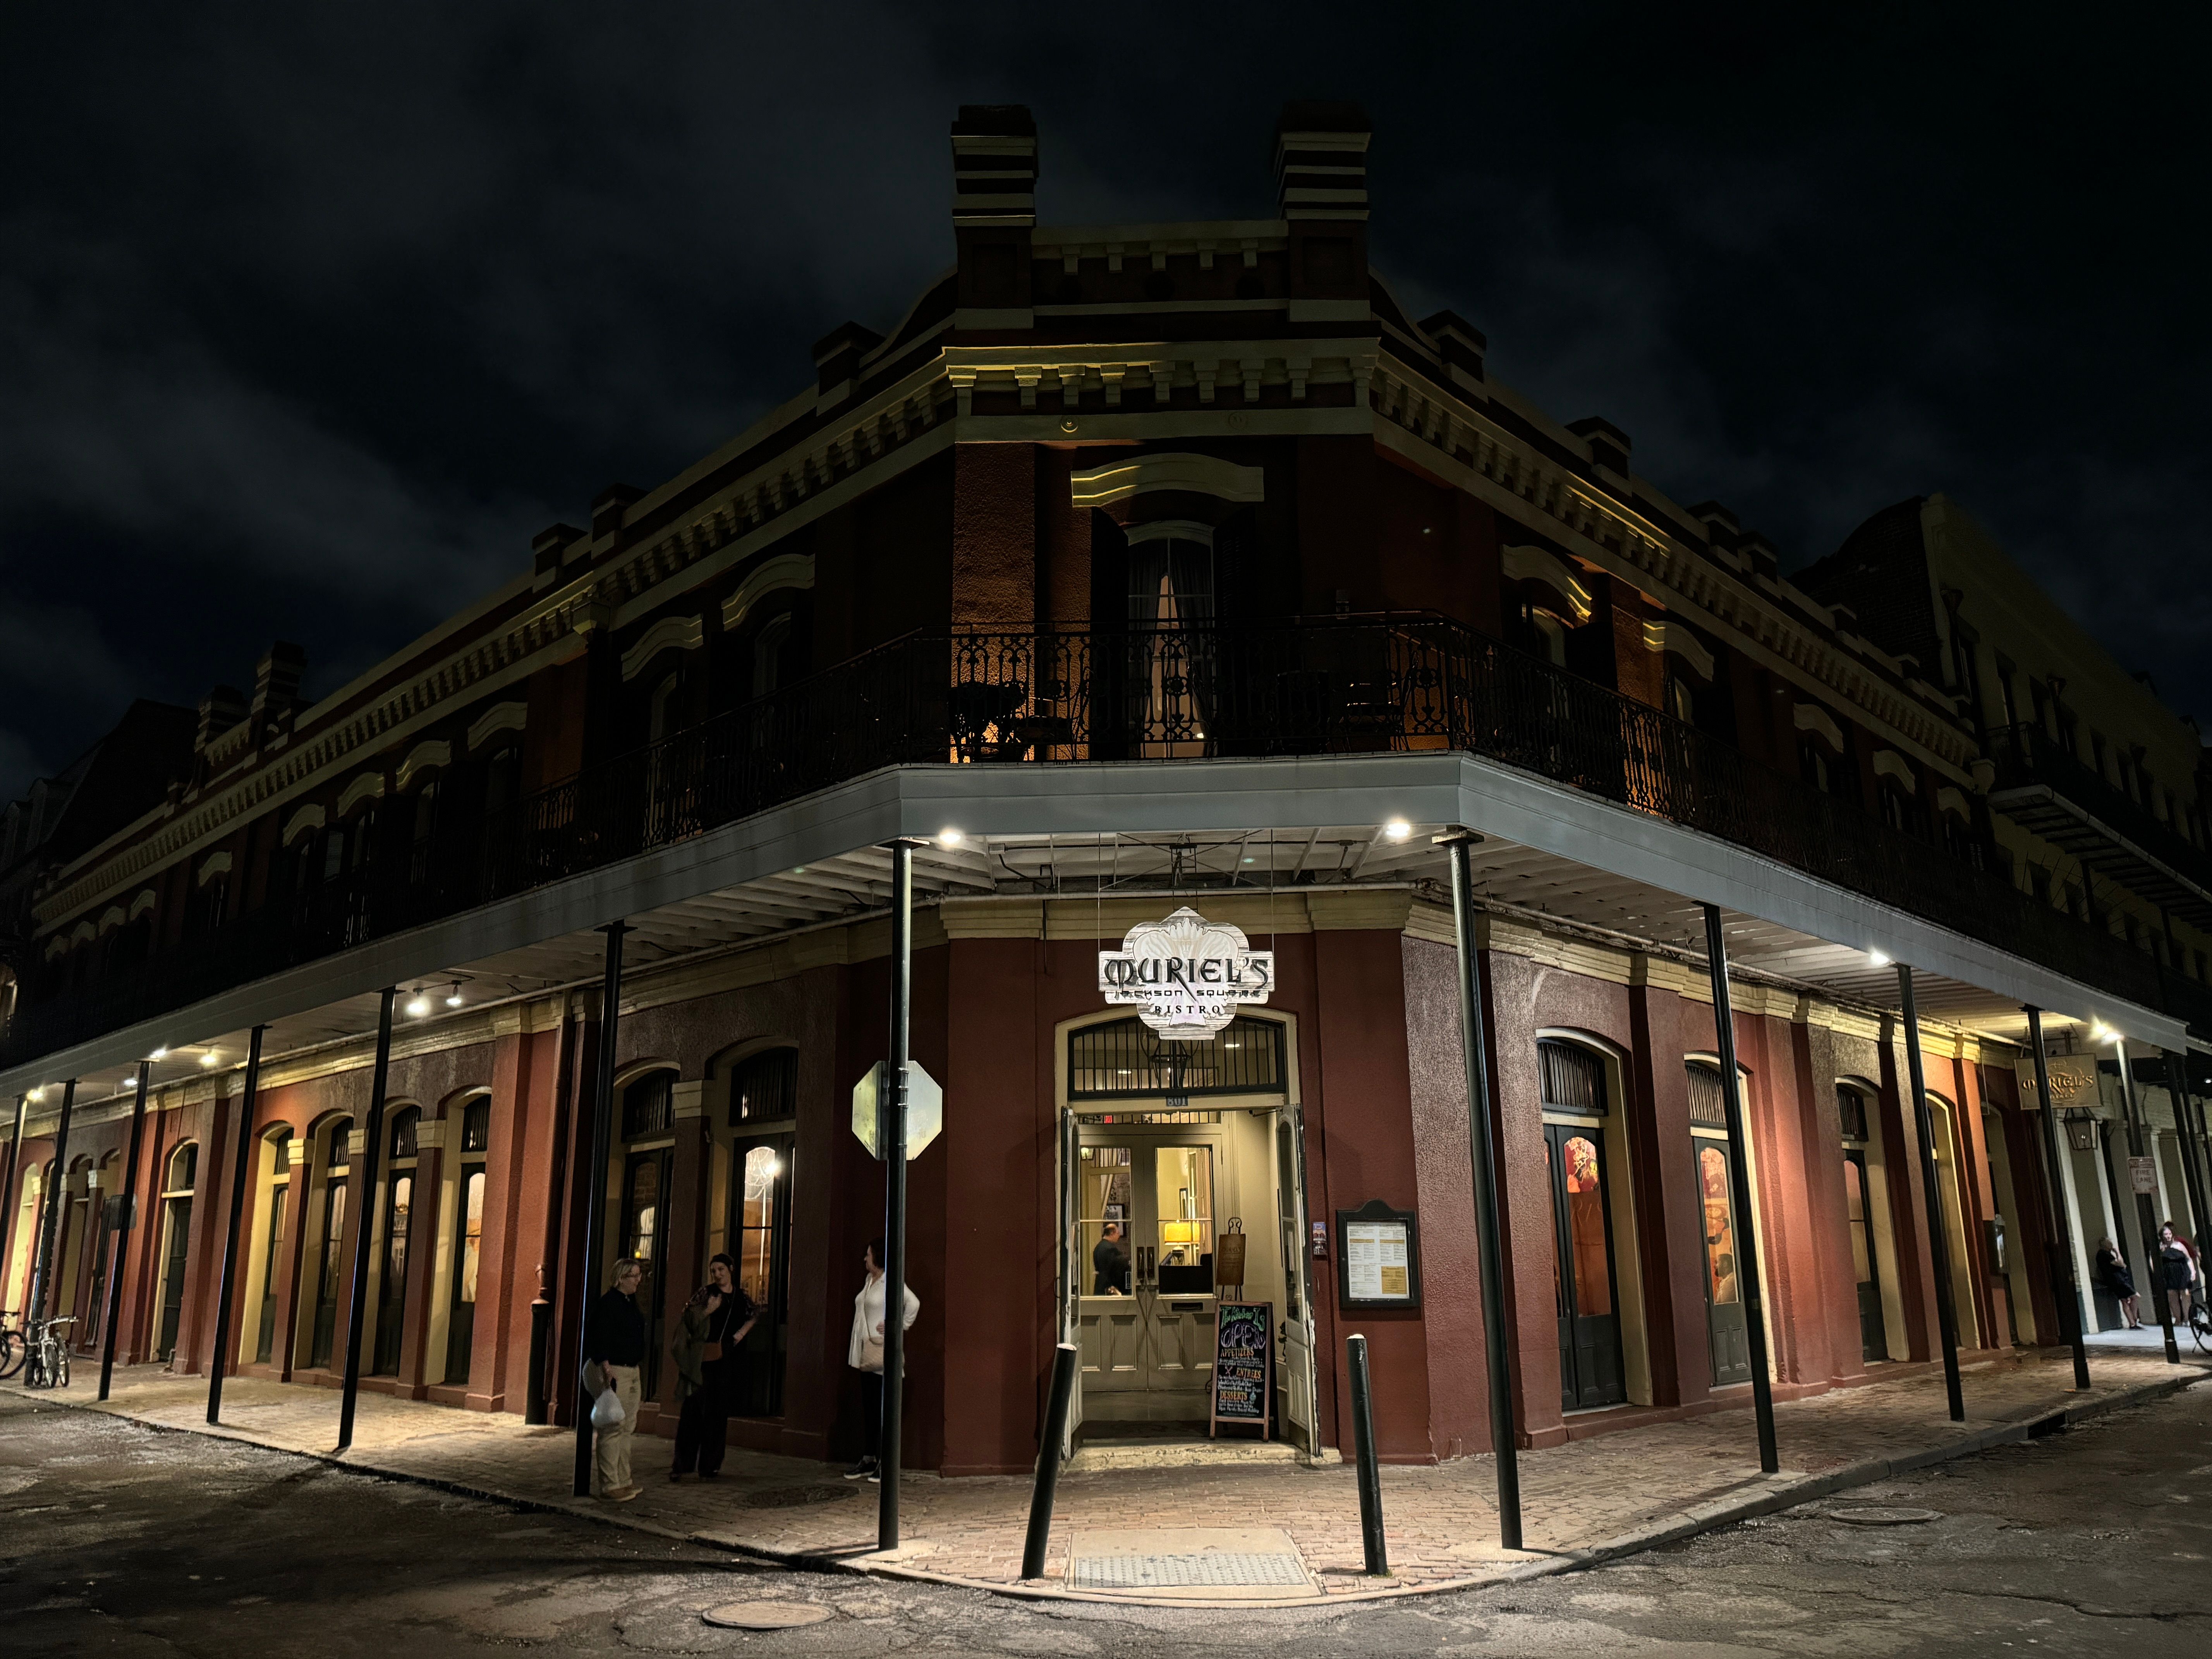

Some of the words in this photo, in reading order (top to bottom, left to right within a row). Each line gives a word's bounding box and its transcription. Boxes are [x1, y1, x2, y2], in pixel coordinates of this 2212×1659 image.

[1104, 957, 1269, 1002] MURIEL'S
[1154, 1005, 1220, 1014] BISTRO
[2022, 1075, 2093, 1094] MRIEL'S
[1167, 1097, 1187, 1106] 801
[1221, 1321, 1266, 1349] OPEN
[1221, 1347, 1254, 1357] APPETIZERS
[1236, 1367, 1261, 1379] ENTREES
[1220, 1390, 1248, 1400] DESSERTS
